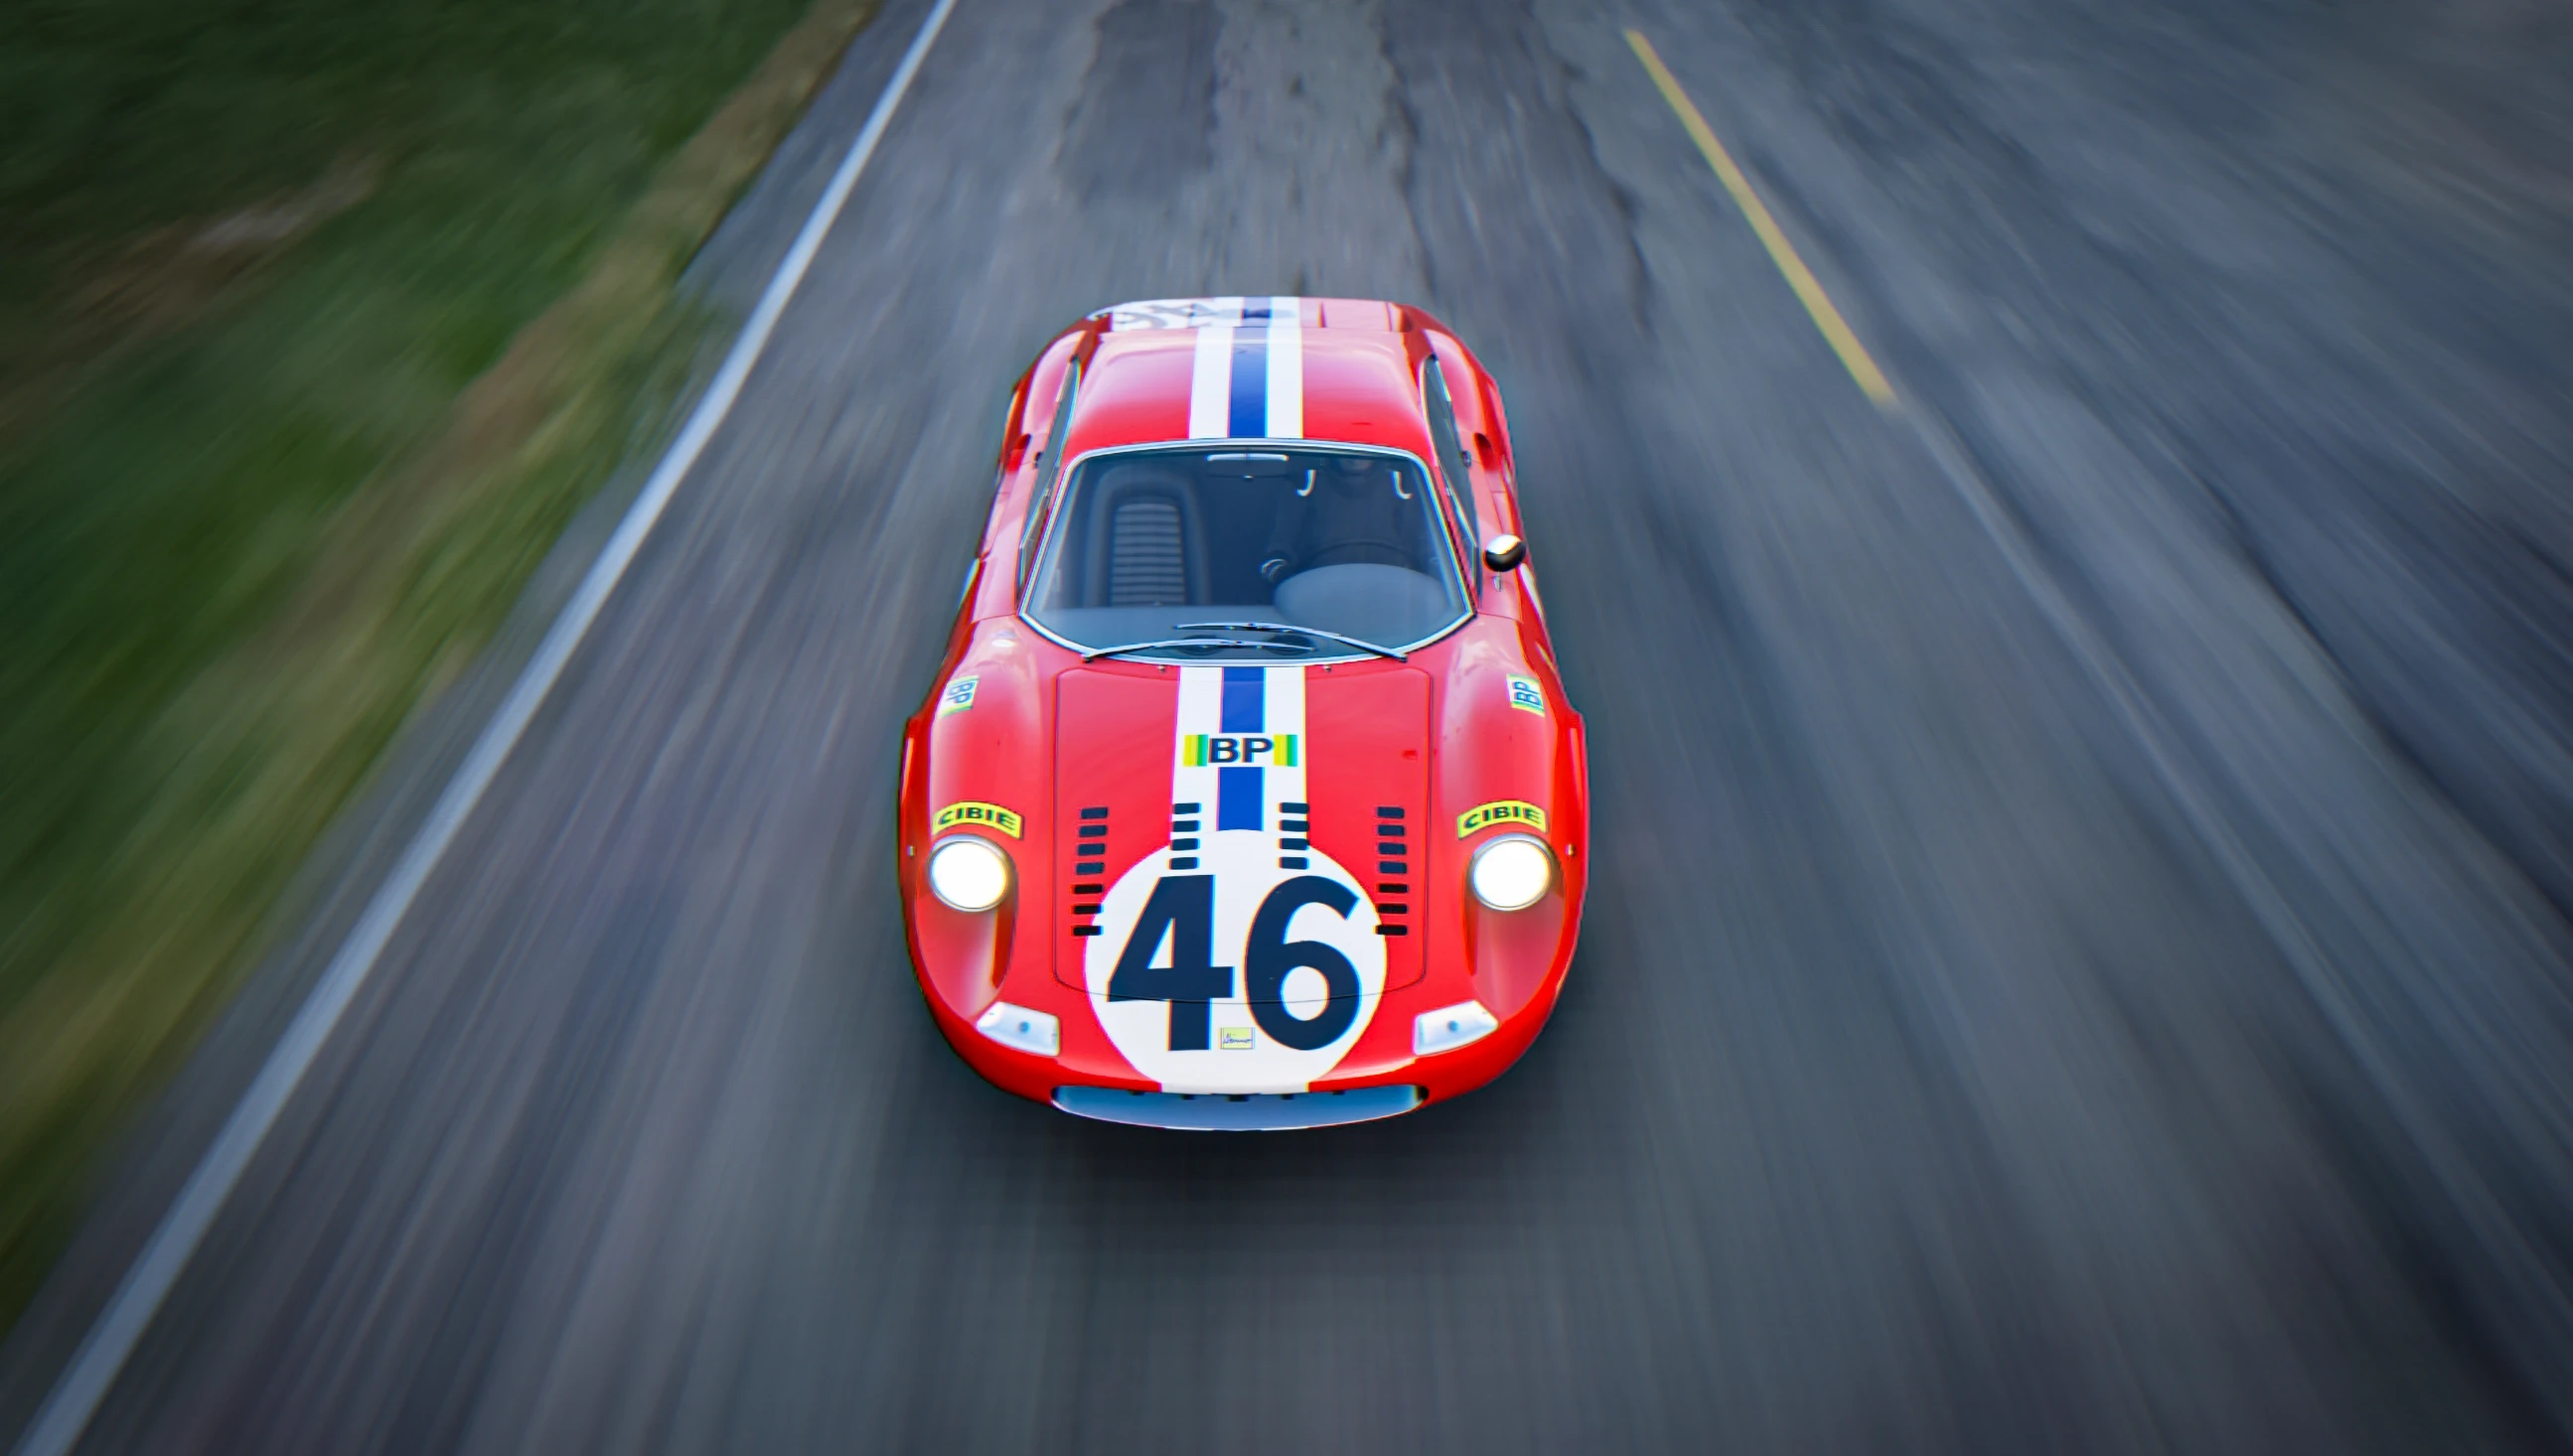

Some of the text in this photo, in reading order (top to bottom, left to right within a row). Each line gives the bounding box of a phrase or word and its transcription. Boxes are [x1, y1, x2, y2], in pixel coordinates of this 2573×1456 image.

[948, 681, 975, 704] BP
[1512, 681, 1542, 706] BP
[1208, 737, 1275, 764] BP
[938, 806, 1016, 831] CIBIE
[1463, 805, 1542, 828] CIBIE
[1107, 874, 1362, 1052] 46
